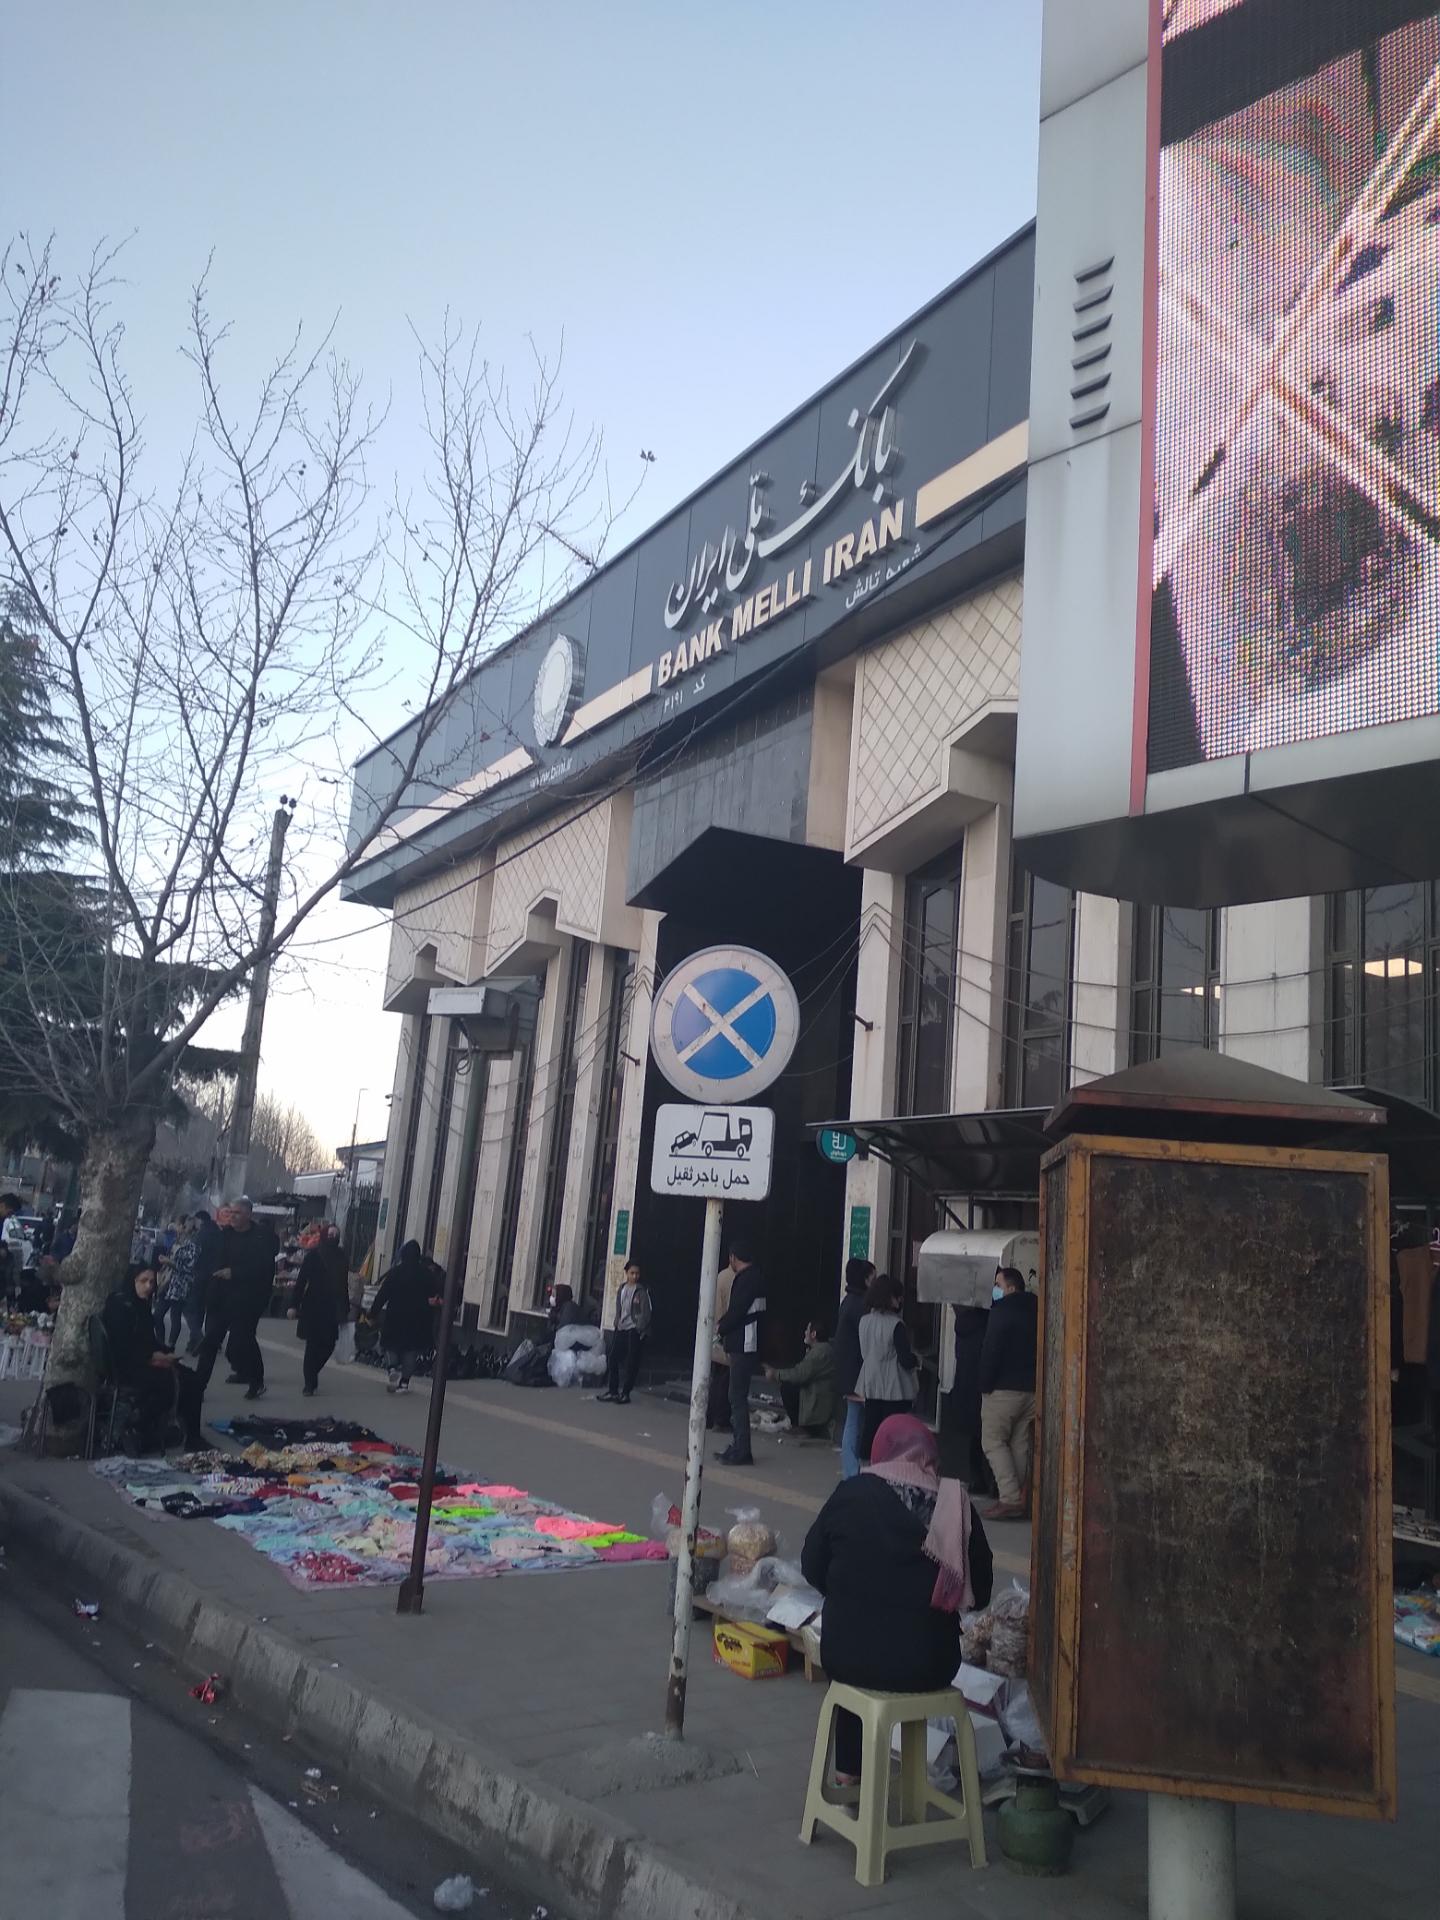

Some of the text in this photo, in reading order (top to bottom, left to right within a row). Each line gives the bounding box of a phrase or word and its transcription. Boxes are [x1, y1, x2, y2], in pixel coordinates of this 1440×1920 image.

[757, 338, 917, 558] بانک
[657, 498, 904, 688] BANK MELLI IRAN
[664, 524, 729, 630] ایران
[845, 569, 881, 609] تالش
[723, 1168, 750, 1190] حمل
